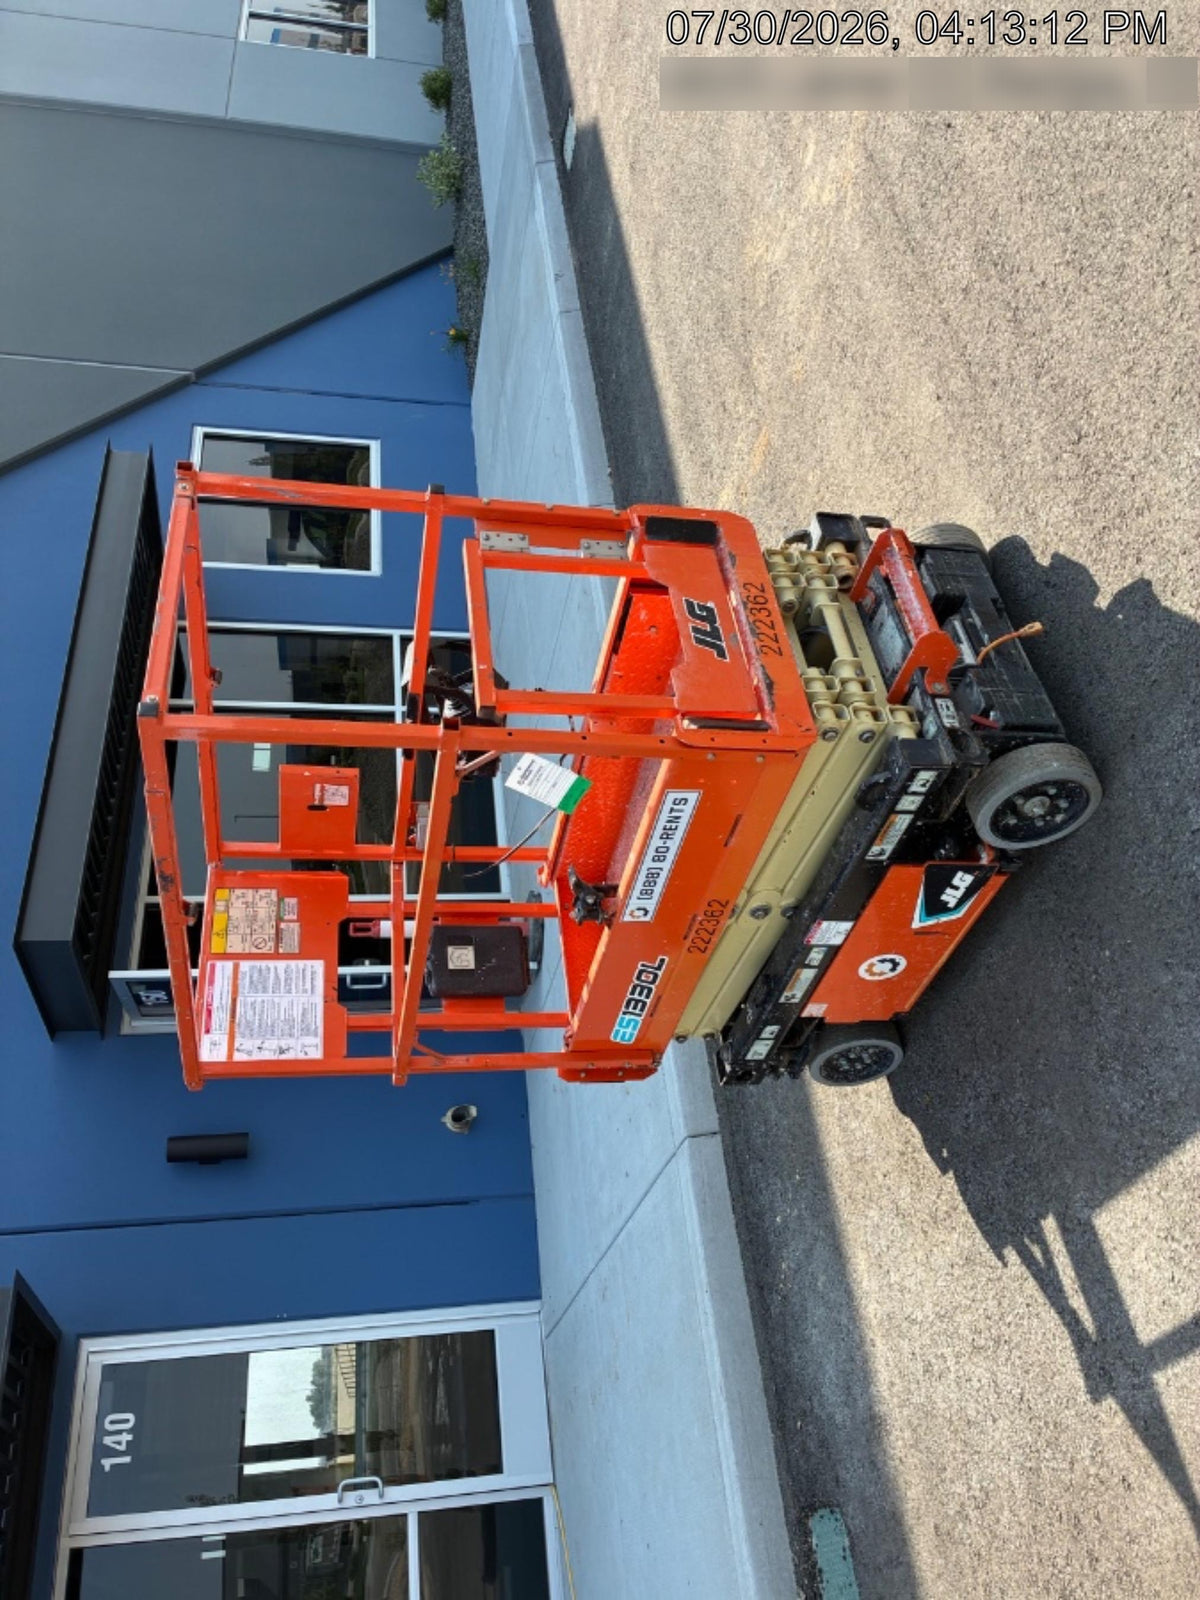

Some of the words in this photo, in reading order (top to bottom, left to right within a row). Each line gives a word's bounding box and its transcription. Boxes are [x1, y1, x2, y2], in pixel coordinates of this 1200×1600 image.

[683, 597, 730, 662] JLG
[743, 582, 783, 657] 222362
[637, 865, 664, 901] (888)
[652, 796, 688, 864] 80-RENTS
[940, 870, 975, 909] JLG
[687, 898, 730, 954] 222362
[611, 955, 668, 1044] ES1330L
[101, 1412, 136, 1472] 140
